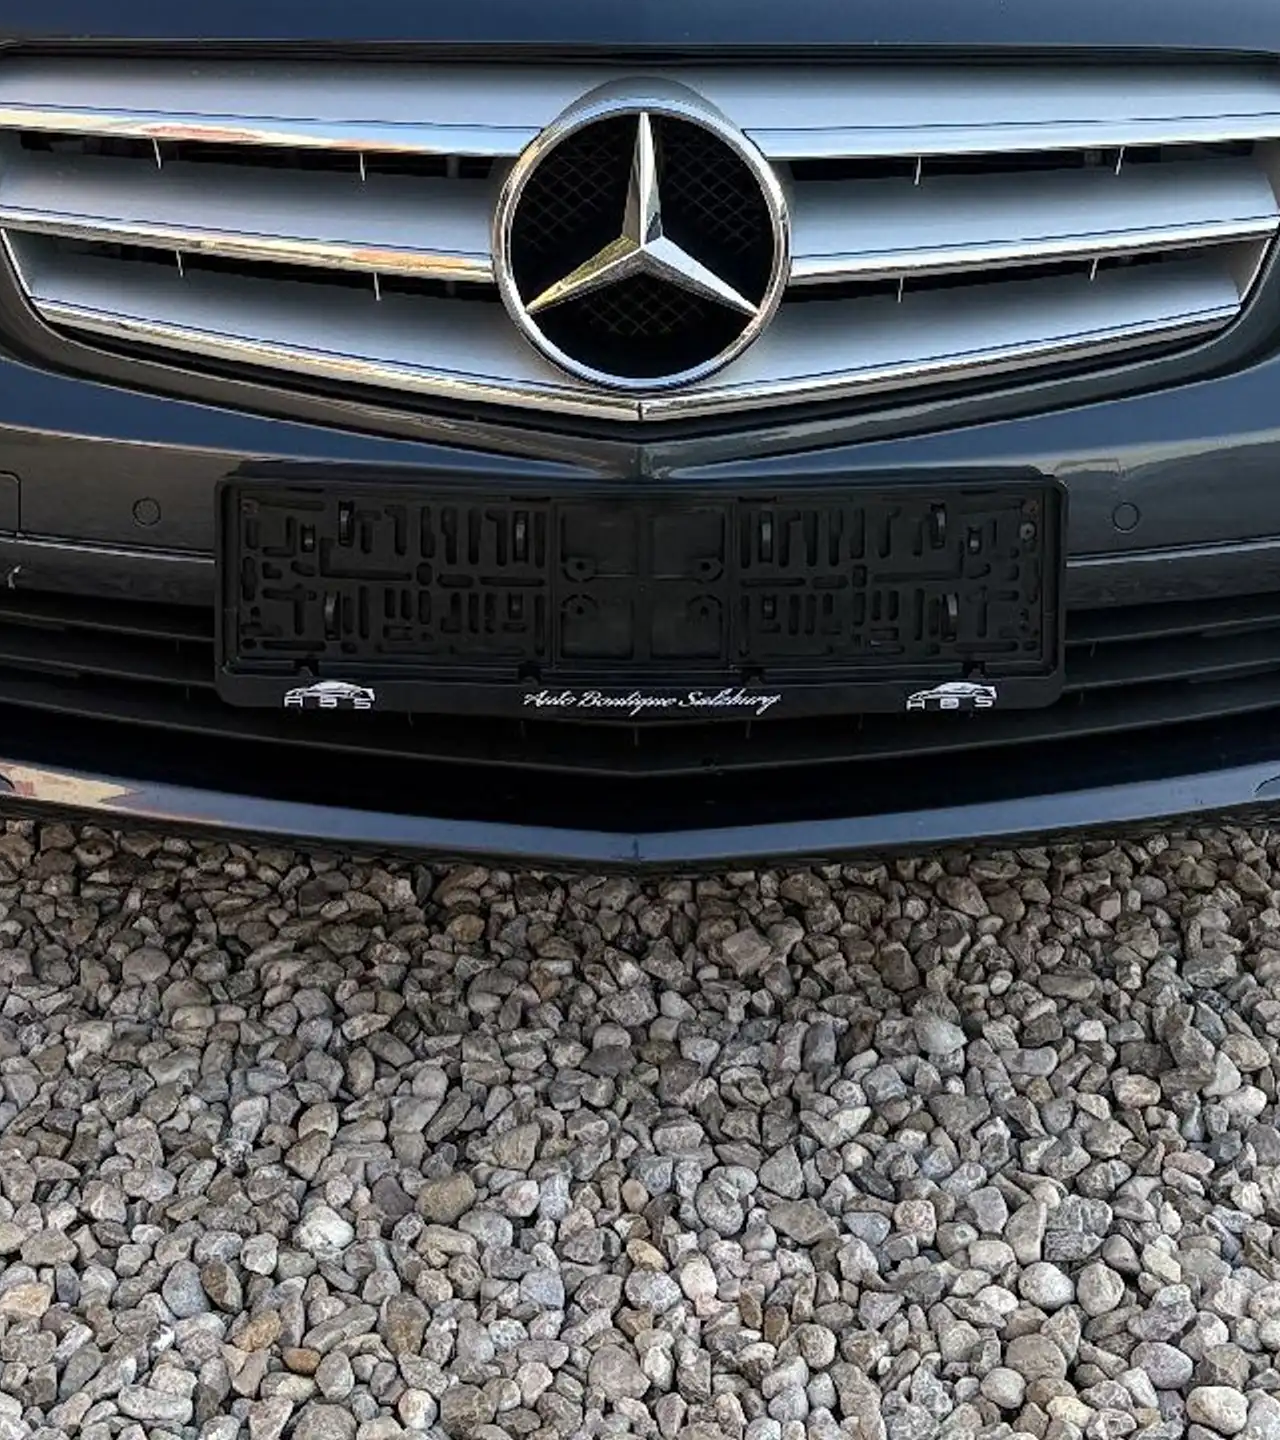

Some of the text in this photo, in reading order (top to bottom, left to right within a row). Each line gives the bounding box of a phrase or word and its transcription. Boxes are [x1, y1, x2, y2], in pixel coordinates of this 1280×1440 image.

[522, 687, 783, 718] Auto Boutique Salzburg
